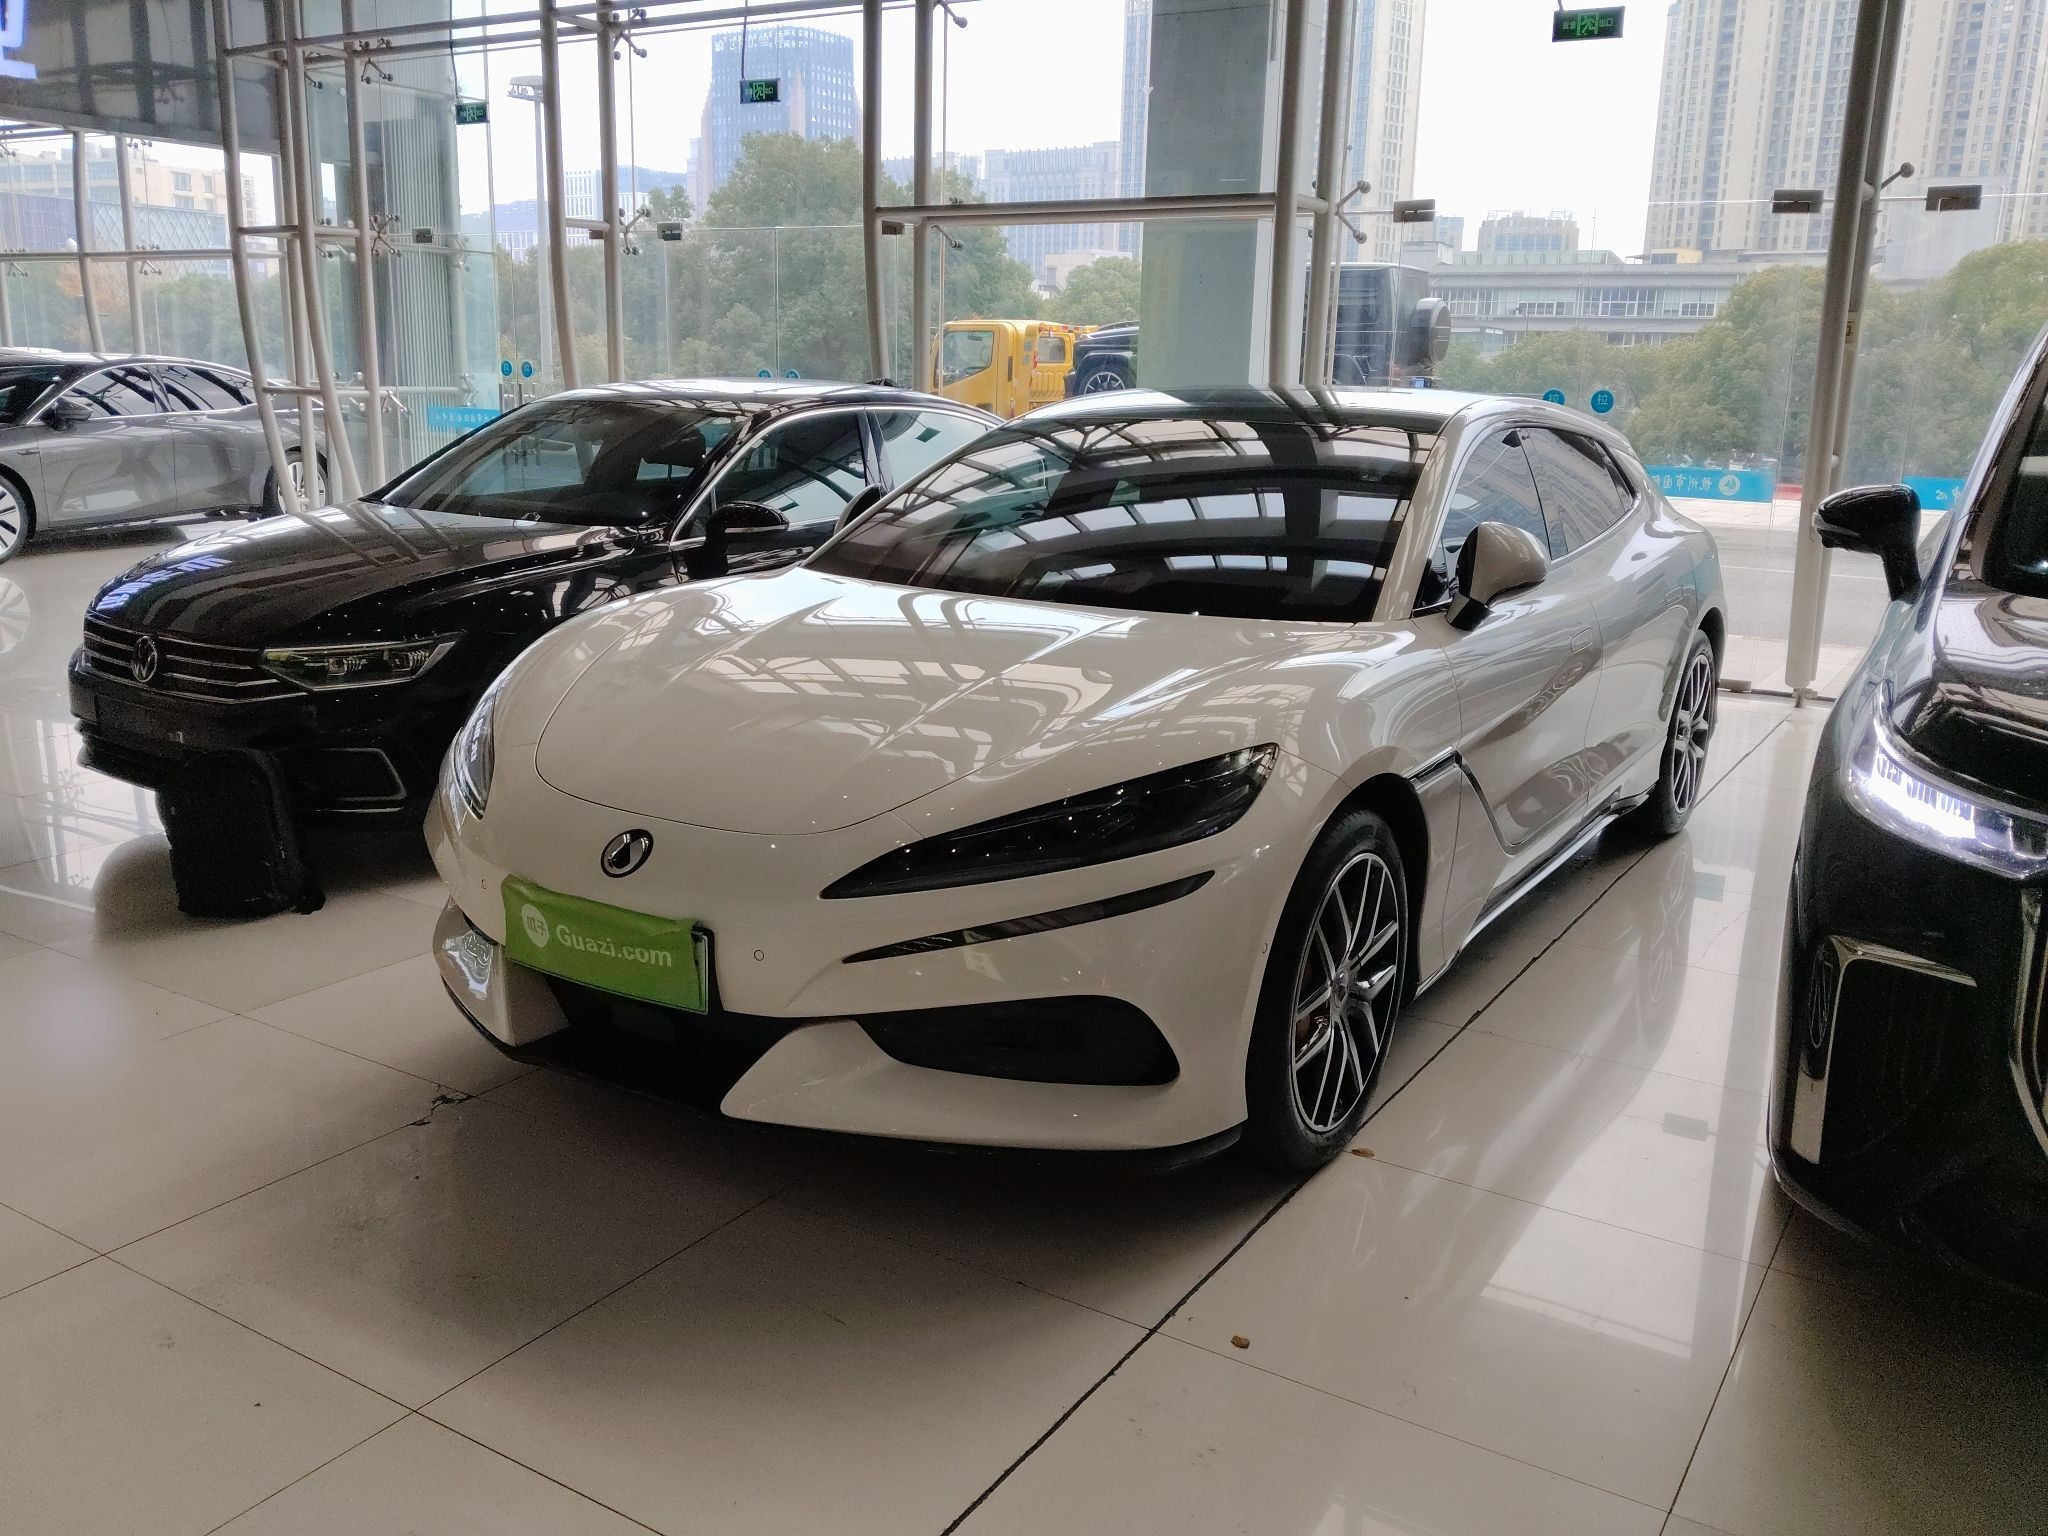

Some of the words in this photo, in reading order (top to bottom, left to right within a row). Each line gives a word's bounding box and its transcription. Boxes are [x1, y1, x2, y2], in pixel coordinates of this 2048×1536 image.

[1599, 17, 1613, 27] 出口
[1597, 393, 1608, 405] 拉
[556, 924, 672, 967] Guazi.com
